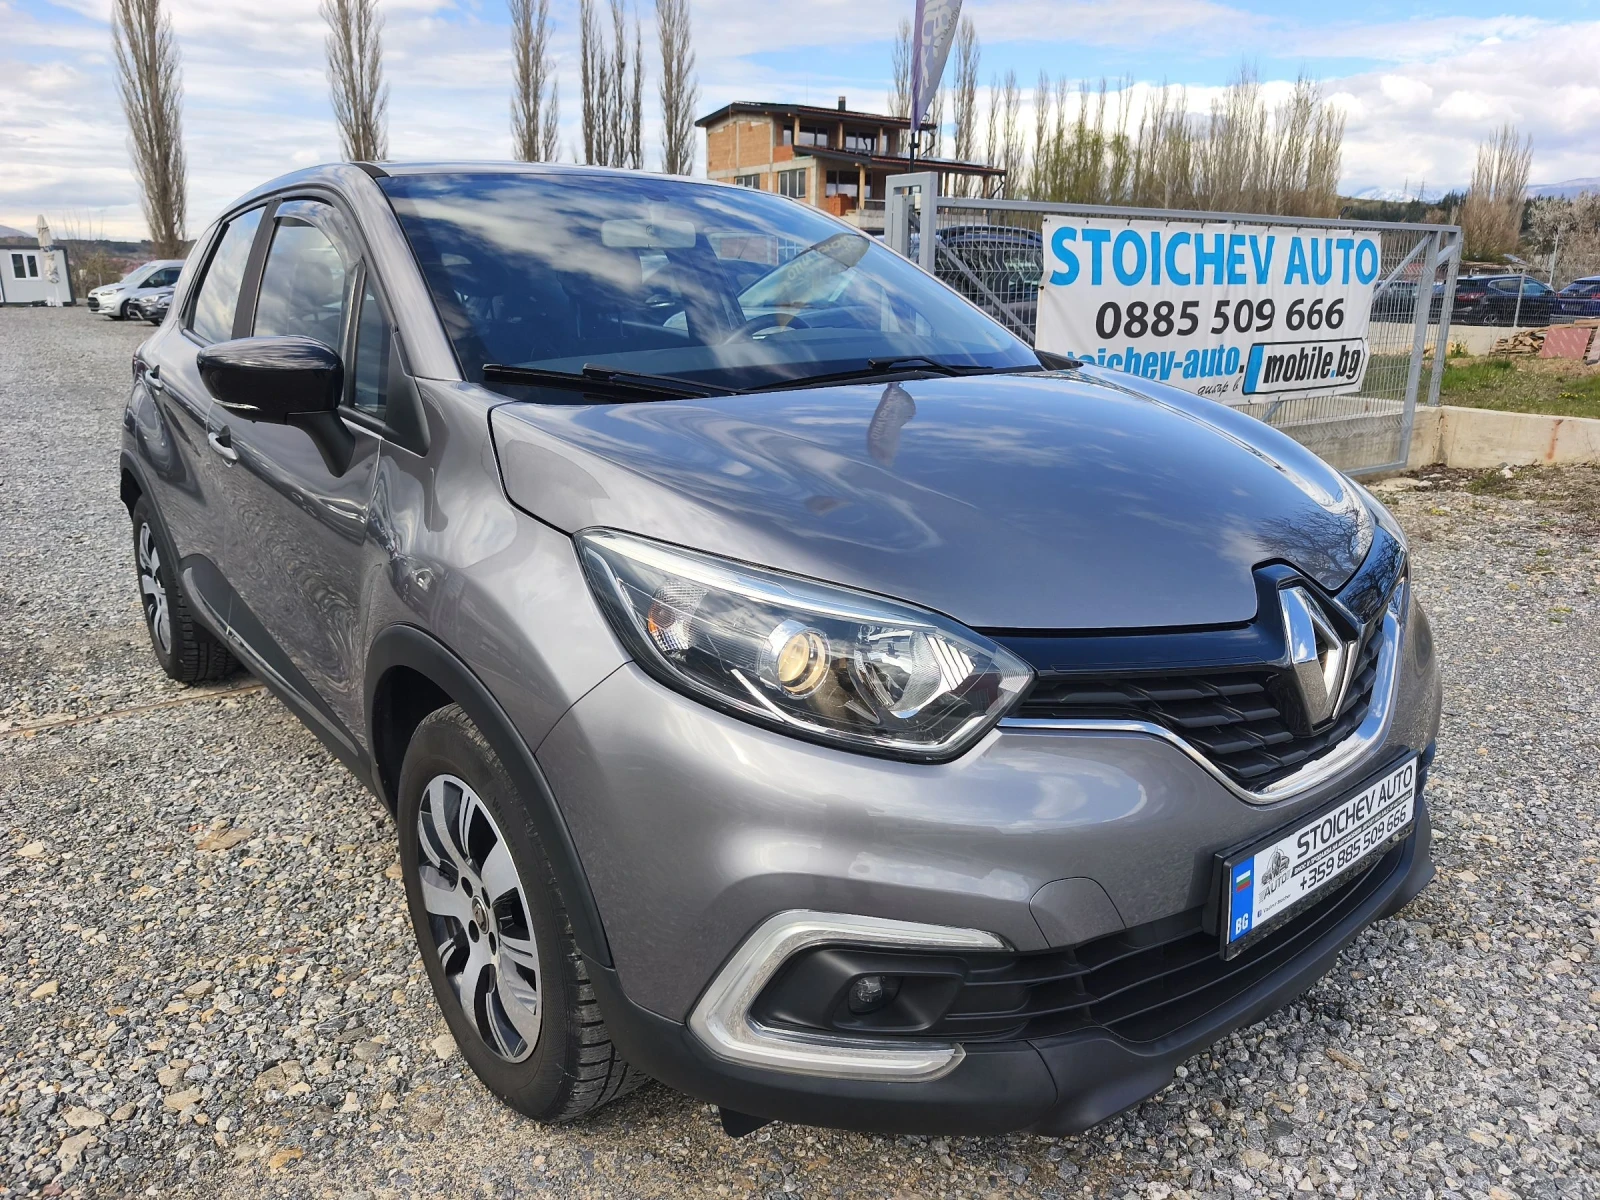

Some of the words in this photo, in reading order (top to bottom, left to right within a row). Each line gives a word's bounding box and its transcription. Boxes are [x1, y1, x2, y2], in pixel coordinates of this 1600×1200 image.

[1049, 227, 1276, 287] STOICHEV
[1284, 236, 1379, 286] AUTO
[1096, 301, 1200, 339] 0885
[1211, 299, 1276, 335] 509
[1286, 298, 1344, 331] 666
[1263, 344, 1361, 384] mobile.bg
[1297, 789, 1376, 860] STOICHEV
[1377, 765, 1413, 808] AUTO
[1299, 857, 1334, 891] +359
[1337, 840, 1362, 869] 885
[1363, 821, 1385, 848] 509
[1387, 804, 1407, 832] 666
[1263, 872, 1287, 900] AUTO
[1235, 912, 1249, 935] BG
